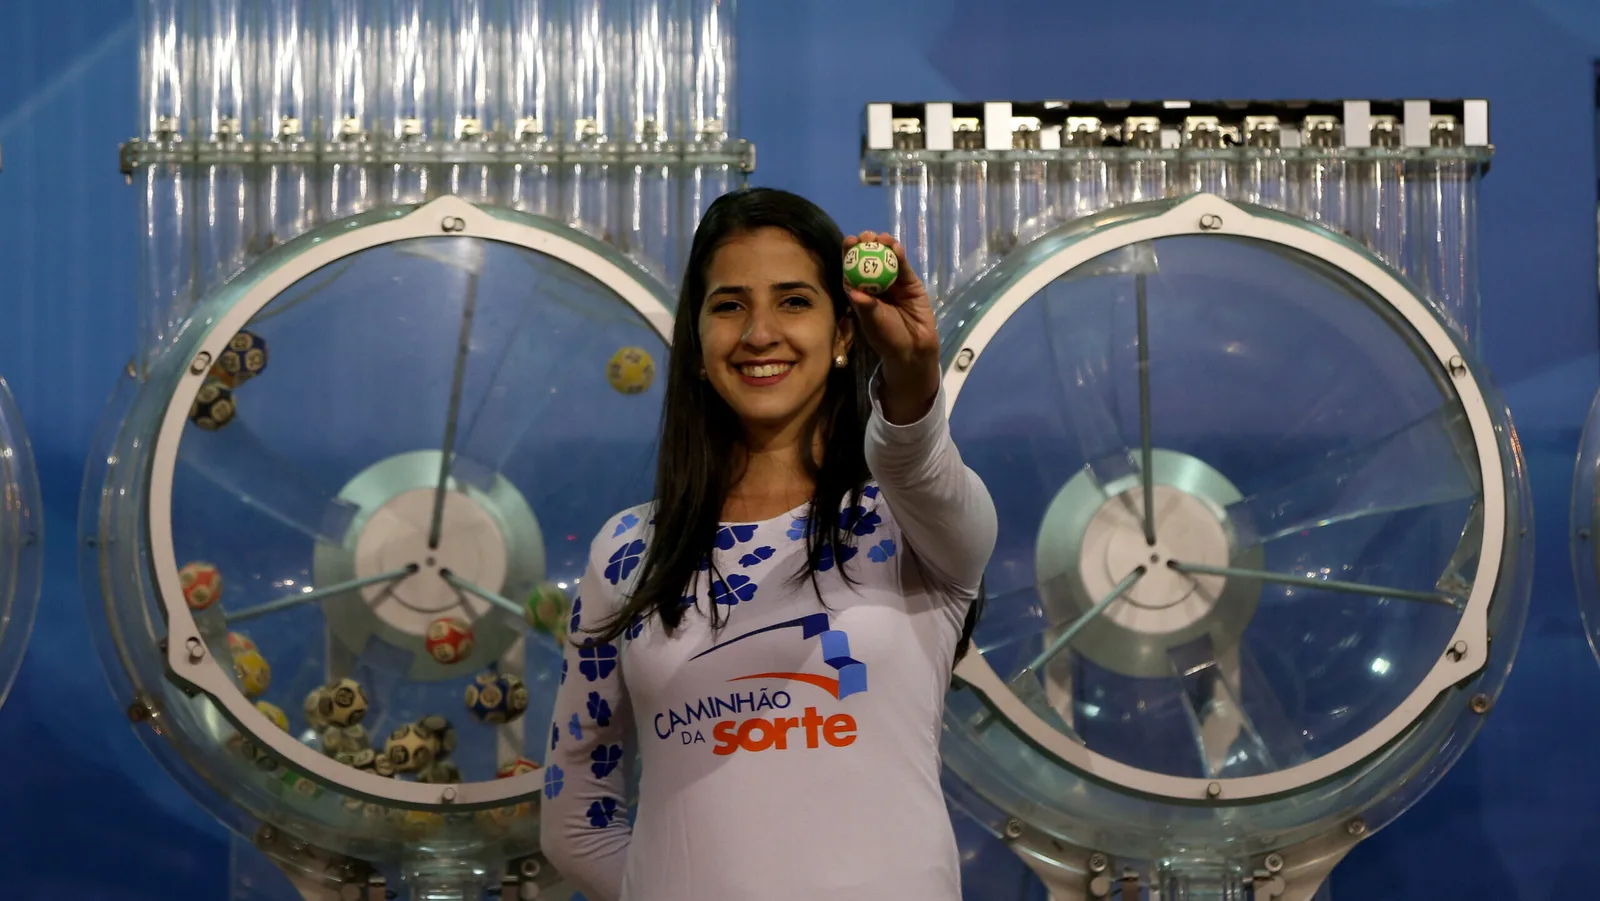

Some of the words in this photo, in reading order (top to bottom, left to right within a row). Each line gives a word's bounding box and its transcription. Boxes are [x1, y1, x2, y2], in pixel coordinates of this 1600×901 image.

[863, 260, 879, 274] 43
[654, 687, 791, 740] CAMINHÃO
[681, 730, 706, 745] DA
[712, 706, 858, 756] sorte
